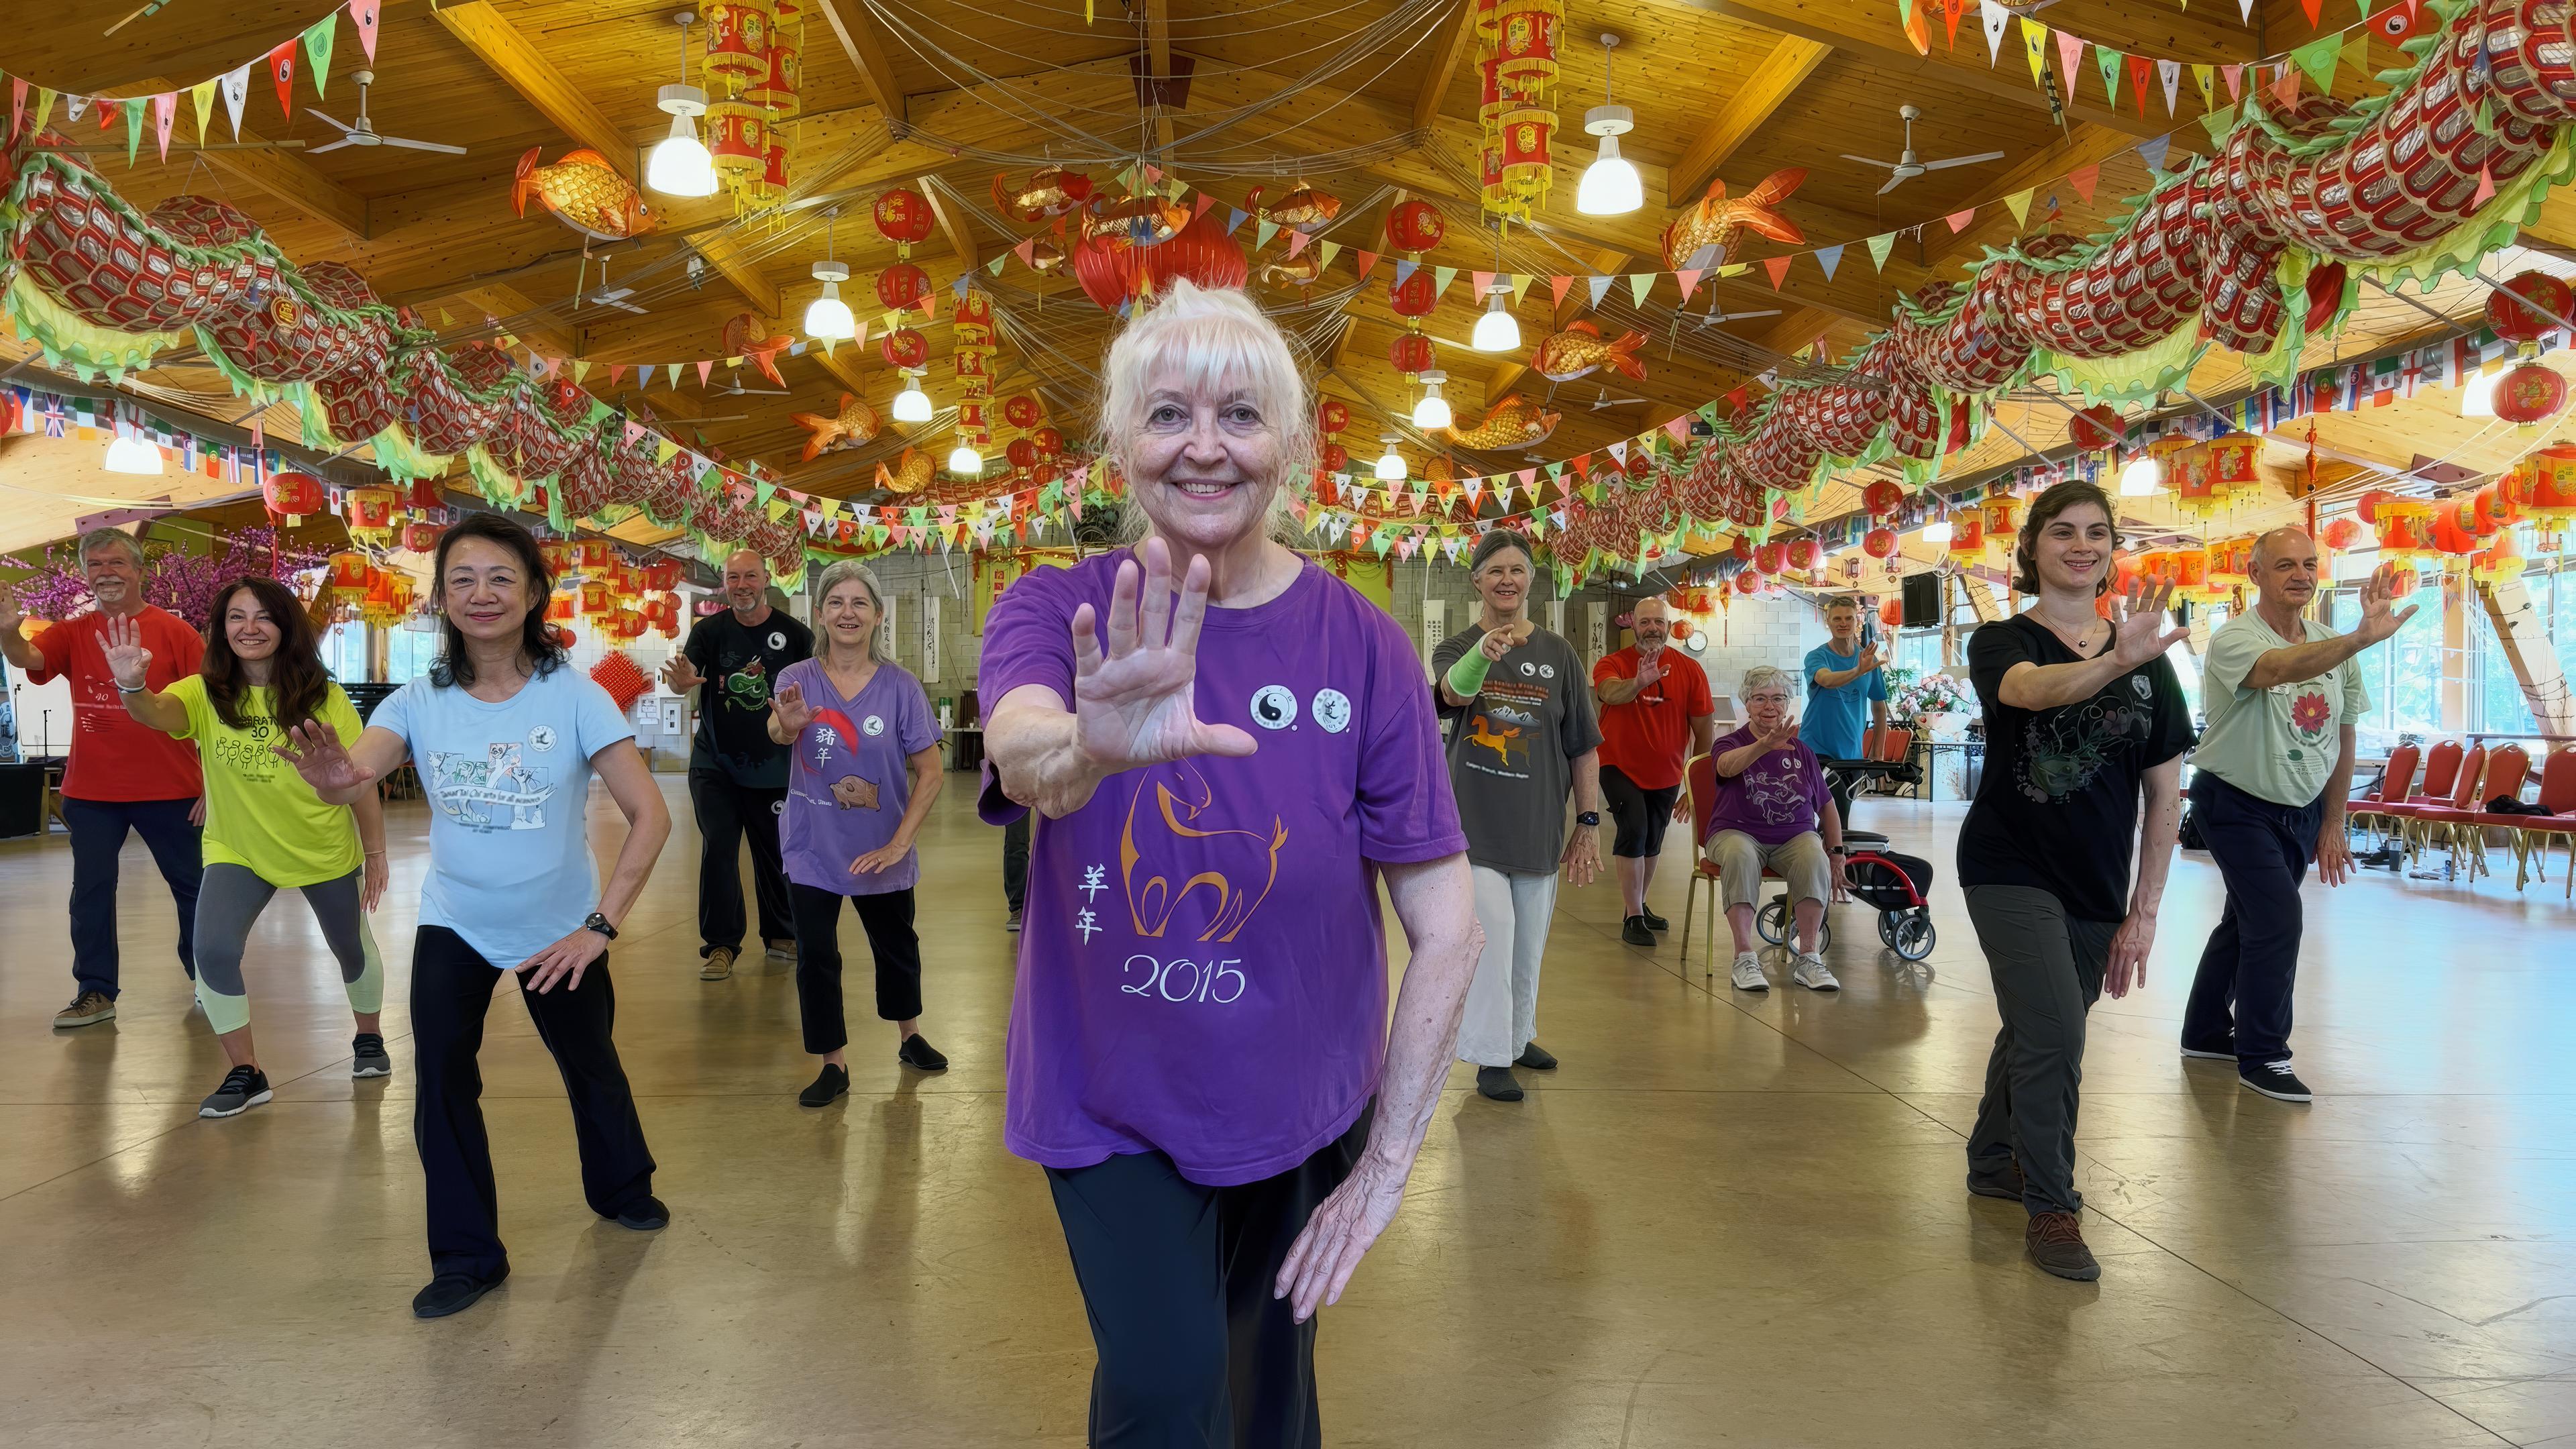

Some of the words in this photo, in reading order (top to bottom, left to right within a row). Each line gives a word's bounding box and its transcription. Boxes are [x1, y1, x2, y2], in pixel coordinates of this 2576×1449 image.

[252, 726, 269, 738] 30
[1075, 863, 1109, 946] 羊年
[1121, 954, 1246, 1004] 2015
